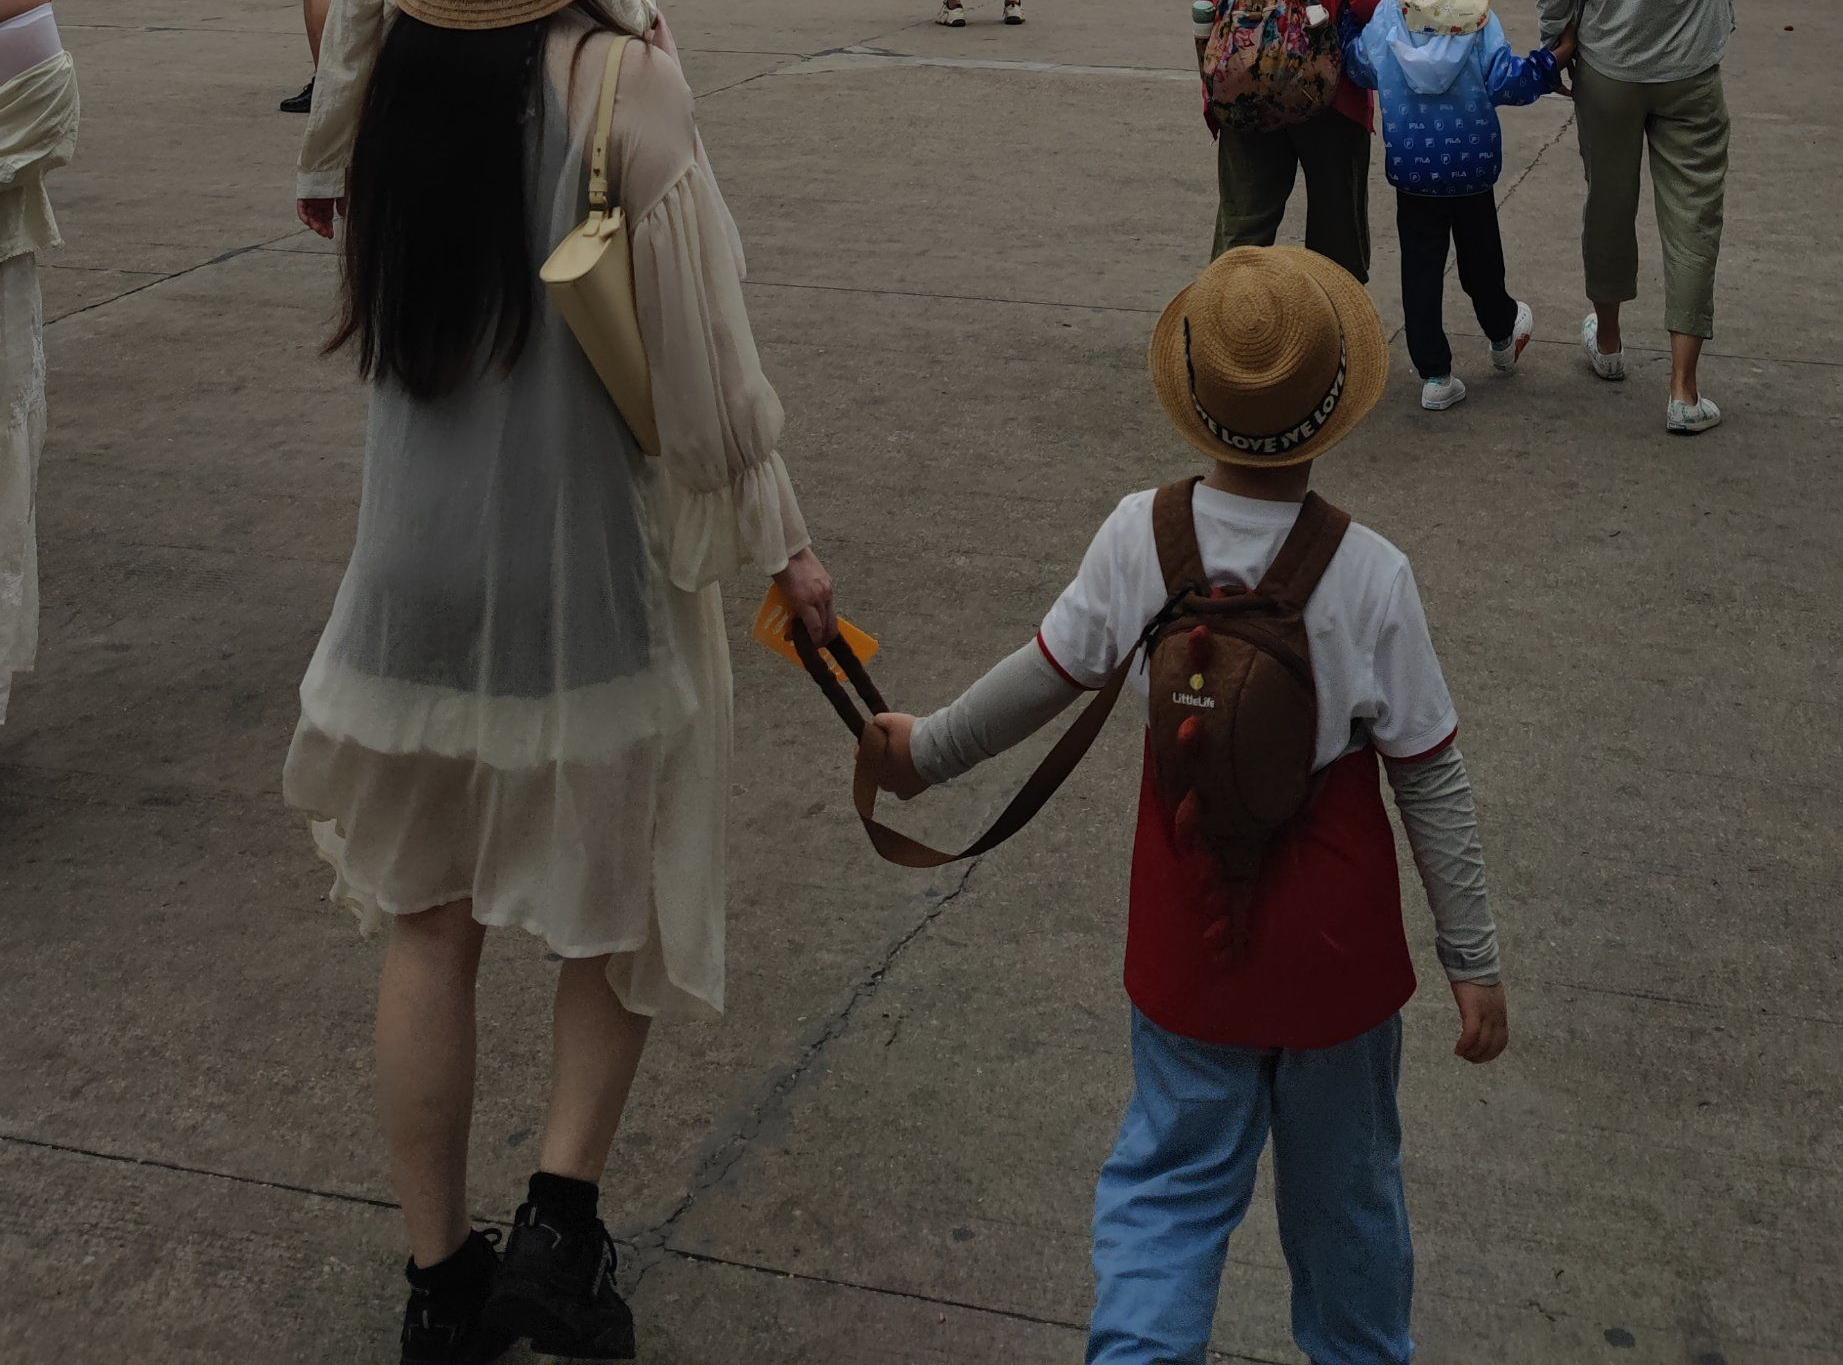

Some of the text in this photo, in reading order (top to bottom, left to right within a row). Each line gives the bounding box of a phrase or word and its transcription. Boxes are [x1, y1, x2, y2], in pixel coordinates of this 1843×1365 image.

[1221, 427, 1278, 453] LOVE
[1313, 368, 1345, 425] LOVE
[1172, 692, 1216, 708] LittleLife
